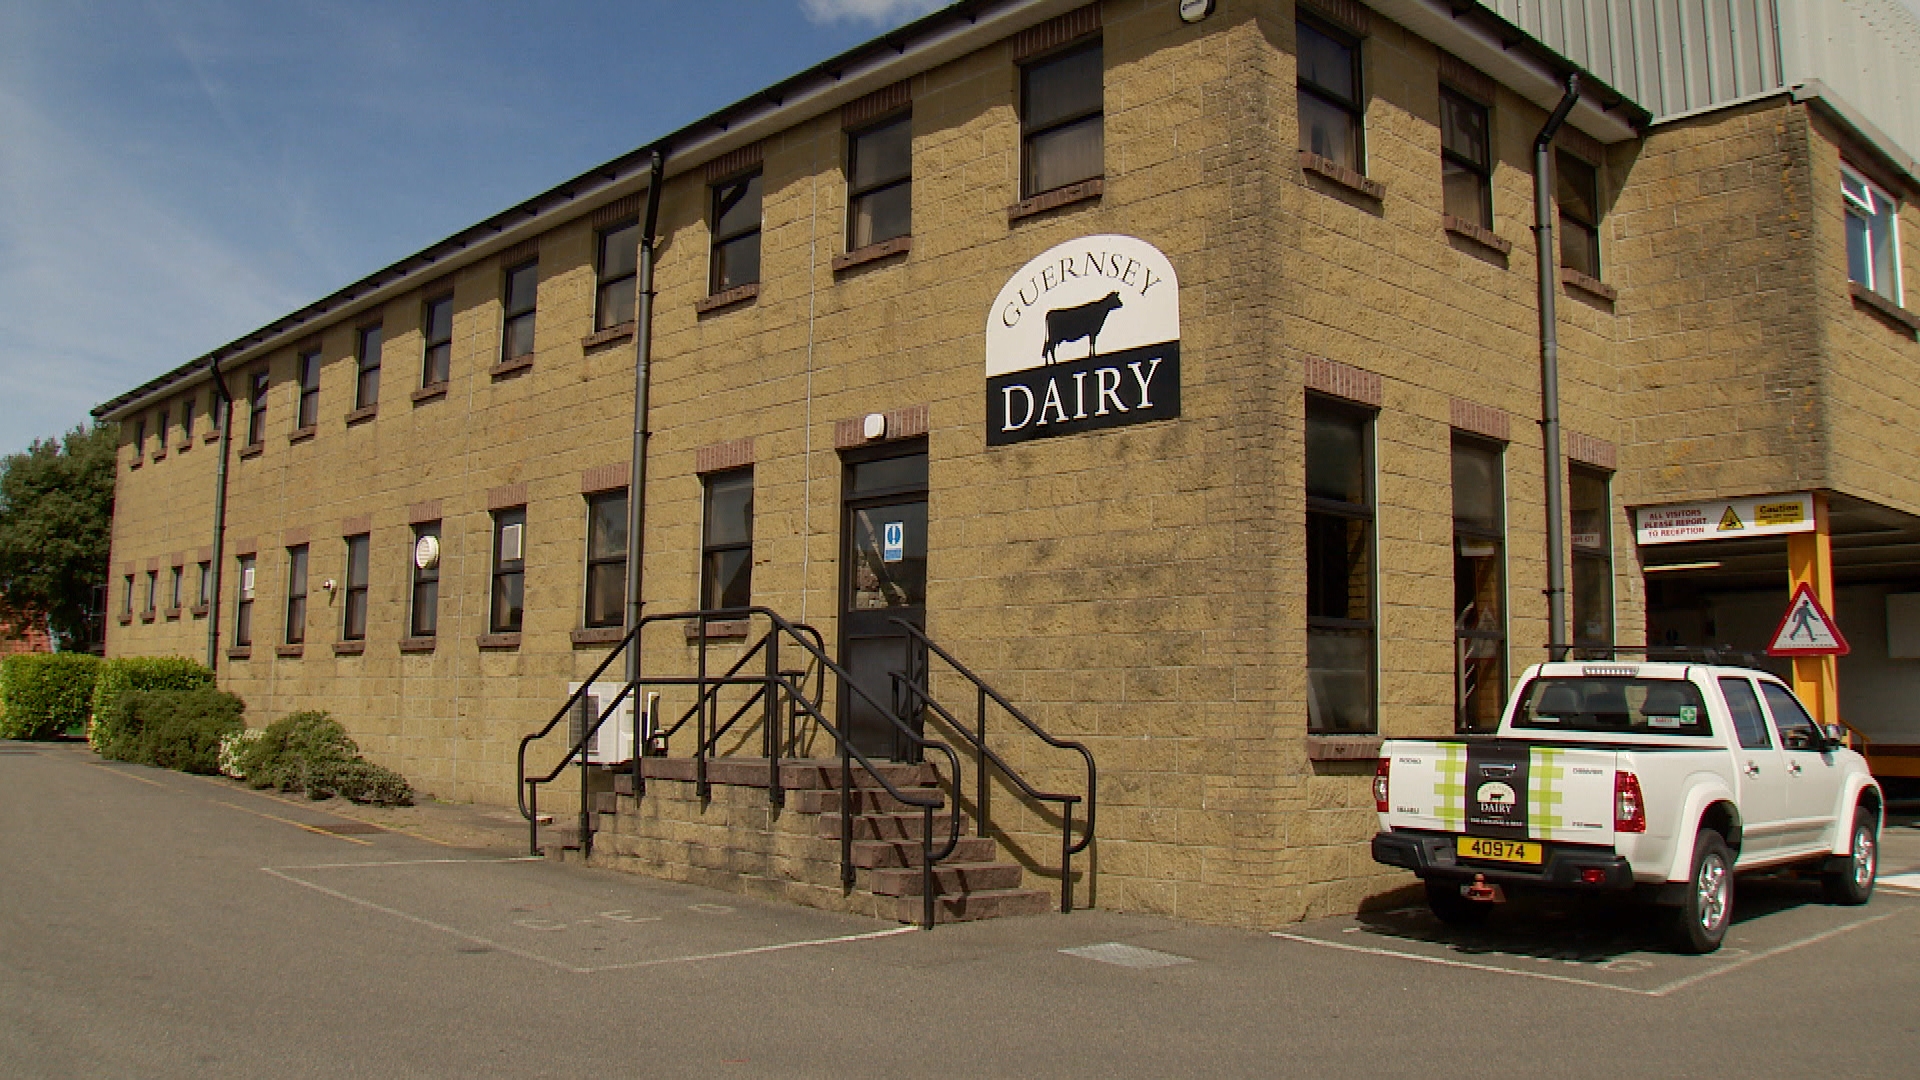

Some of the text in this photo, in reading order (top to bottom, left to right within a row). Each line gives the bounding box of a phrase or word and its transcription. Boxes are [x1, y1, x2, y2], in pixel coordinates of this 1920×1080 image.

[1002, 251, 1162, 328] GUERNSEY
[1001, 357, 1162, 433] DAIRY
[1650, 509, 1702, 520] ALL VISITORS
[1759, 504, 1799, 514] Caution
[1644, 517, 1707, 529] PLEASE REPORT
[1648, 526, 1705, 538] TO RECEPTION
[1480, 802, 1512, 814] DAIRY
[1471, 839, 1526, 859] 40974
